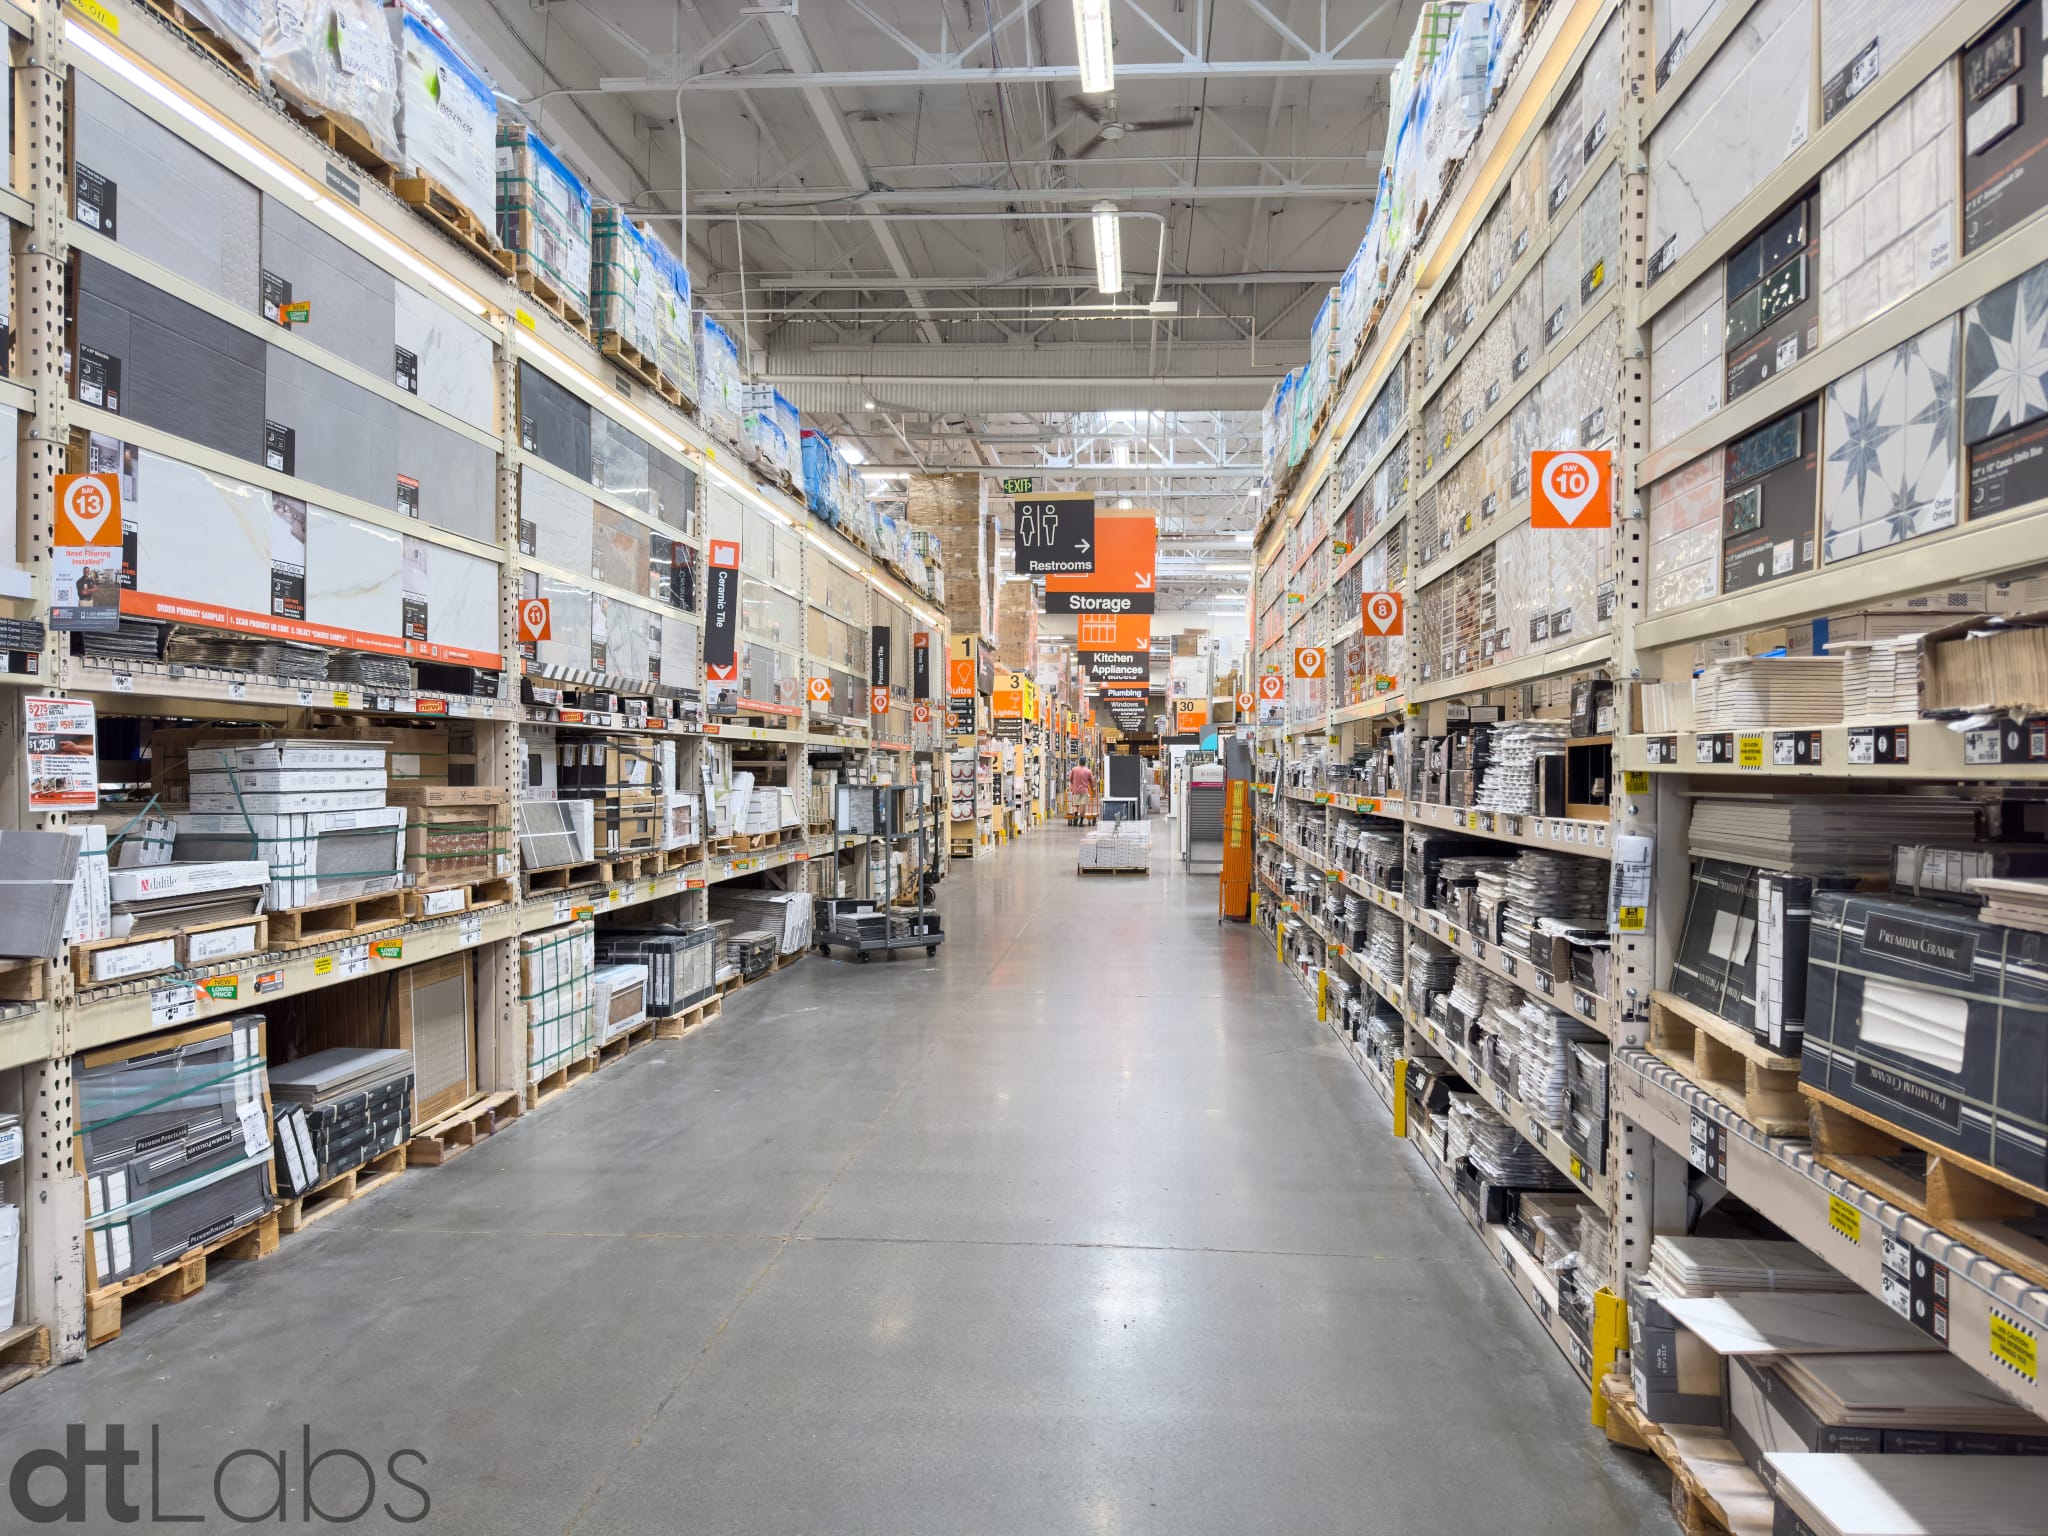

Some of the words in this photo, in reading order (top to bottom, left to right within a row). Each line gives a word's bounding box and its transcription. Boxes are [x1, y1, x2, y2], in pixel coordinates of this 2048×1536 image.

[1008, 480, 1028, 492] EXIT
[1556, 474, 1586, 493] 10
[76, 496, 100, 514] 13
[1935, 498, 1952, 509] Order
[1932, 510, 1951, 522] Online
[1029, 561, 1092, 571] Restrooms
[716, 571, 728, 610] Ceramic
[1069, 595, 1131, 612] Storage
[1378, 605, 1387, 616] 8
[157, 604, 176, 614] ORDER
[177, 607, 200, 618] PRODUCT
[201, 611, 224, 622] SAMPLES
[236, 617, 248, 626] SCAN
[249, 620, 269, 630] PRODUCT
[530, 611, 541, 623] 11
[716, 611, 727, 628] Tile
[962, 638, 970, 656] 1
[1094, 653, 1133, 662] Kitchen
[1092, 665, 1143, 675] Appliances
[1010, 675, 1020, 688] 3
[419, 702, 442, 712] new!
[1180, 702, 1194, 711] 30
[1071, 714, 1076, 722] 8
[29, 739, 55, 753] $1,250
[1878, 929, 1918, 950] PREMIUM
[1920, 939, 1957, 960] CERAMIC
[1868, 1067, 1901, 1091] CERAMIC
[1903, 1081, 1946, 1111] PREMIUM
[138, 1137, 161, 1149] PREMIUM
[161, 1129, 187, 1143] PORCELAIN
[210, 1133, 230, 1145] PREMIUM
[188, 1140, 212, 1154] PORCELAIN
[190, 1231, 211, 1244] PREMIUM
[210, 1220, 234, 1234] PORCELAIN
[1997, 1325, 2007, 1336] USE
[2007, 1331, 2029, 1348] CAUTION
[2000, 1343, 2017, 1358] SINGLE
[2017, 1353, 2027, 1365] TILE
[2005, 1338, 2035, 1361] RETRIEVING
